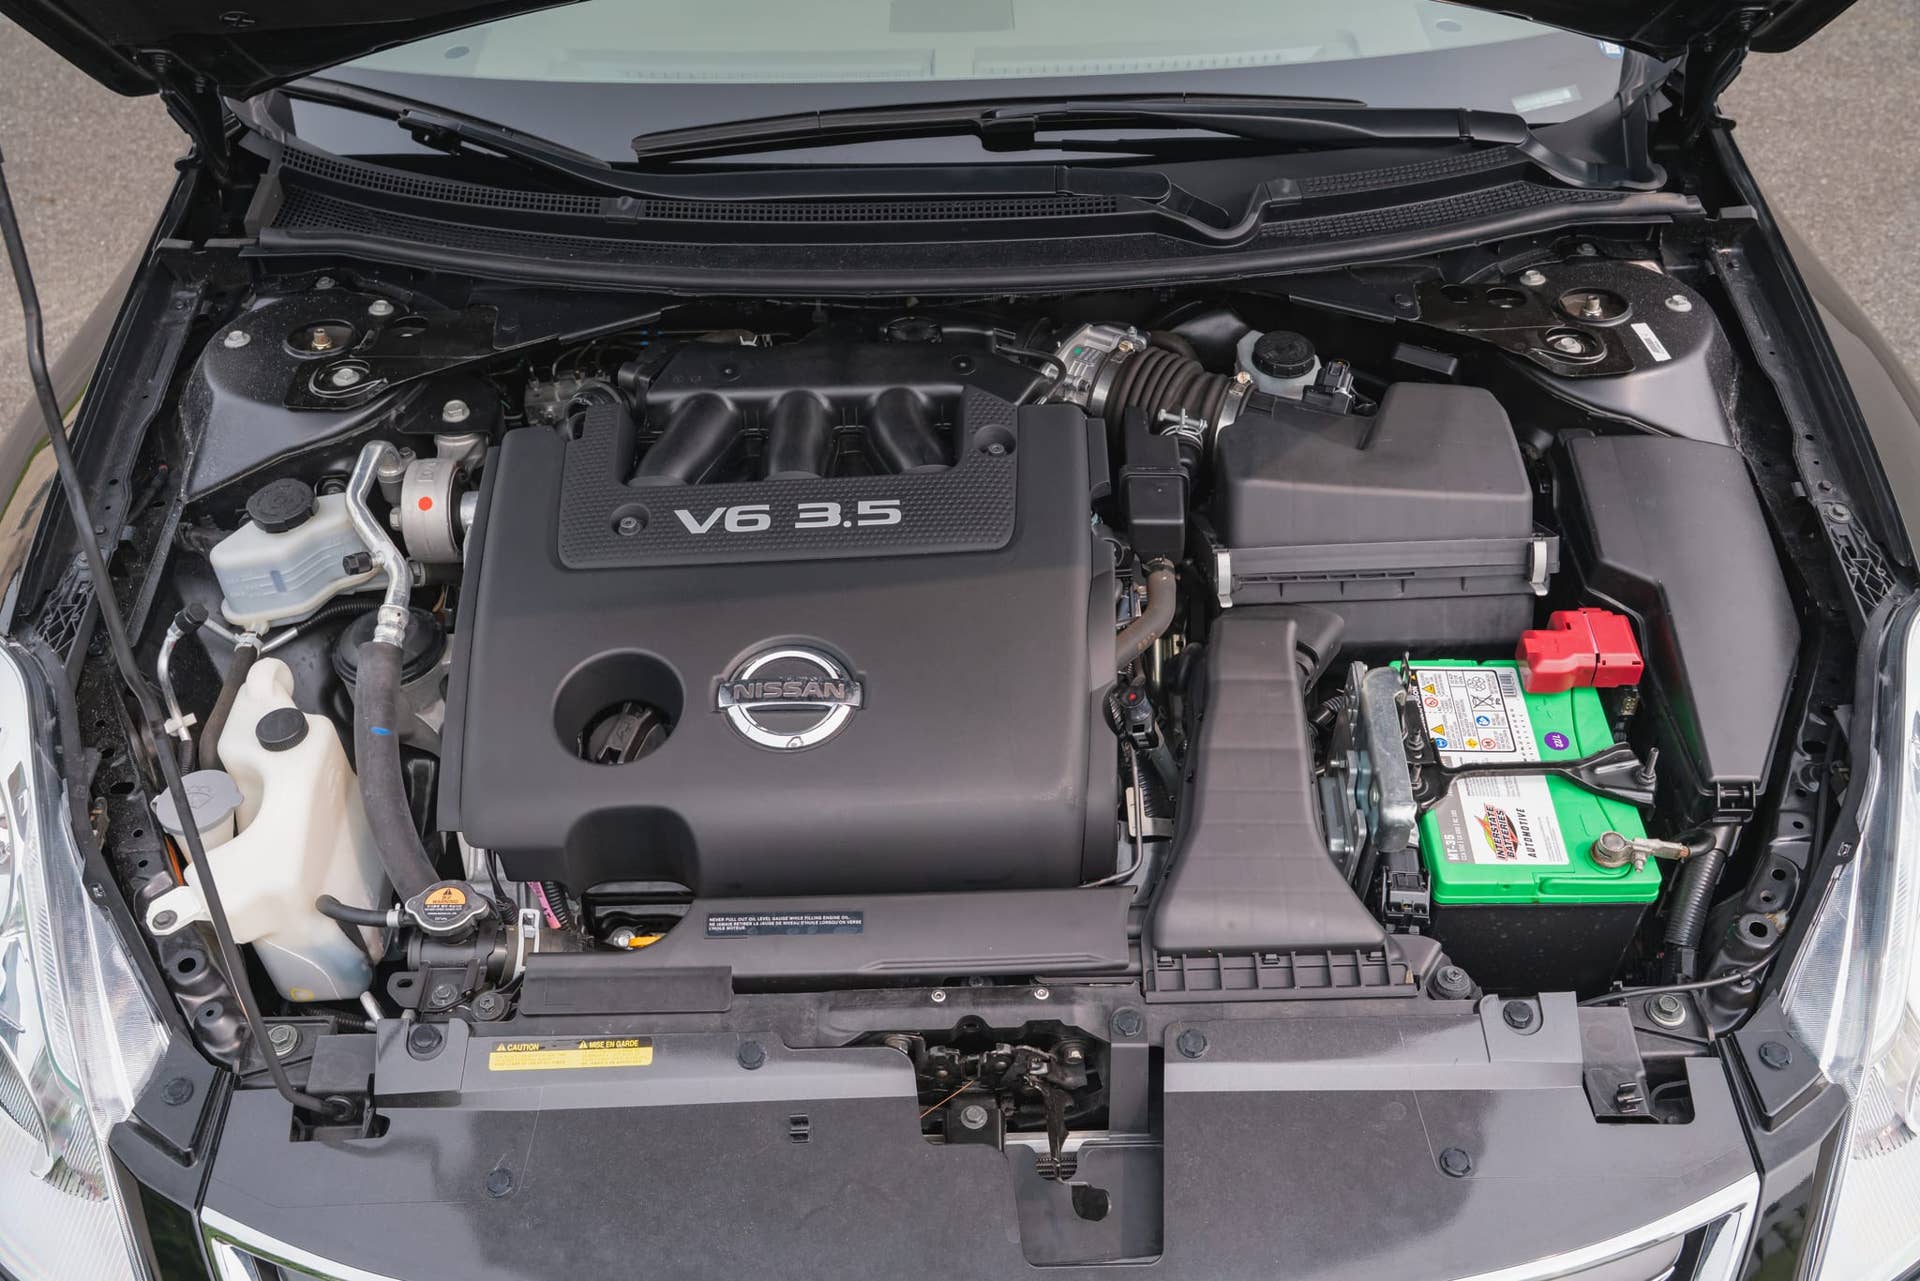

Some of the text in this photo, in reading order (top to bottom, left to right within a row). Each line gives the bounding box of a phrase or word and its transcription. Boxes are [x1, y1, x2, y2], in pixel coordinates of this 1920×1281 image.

[673, 499, 902, 534] V6 3.5
[733, 681, 846, 700] NISSAN
[1486, 804, 1506, 859] INTERSTATE
[1496, 809, 1515, 858] BATTERIES
[1516, 807, 1537, 858] AUTOMOTIVE
[1444, 834, 1459, 861] MT-35
[507, 1042, 540, 1052] CAUTION
[589, 1039, 639, 1049] MISE EN GARDE
